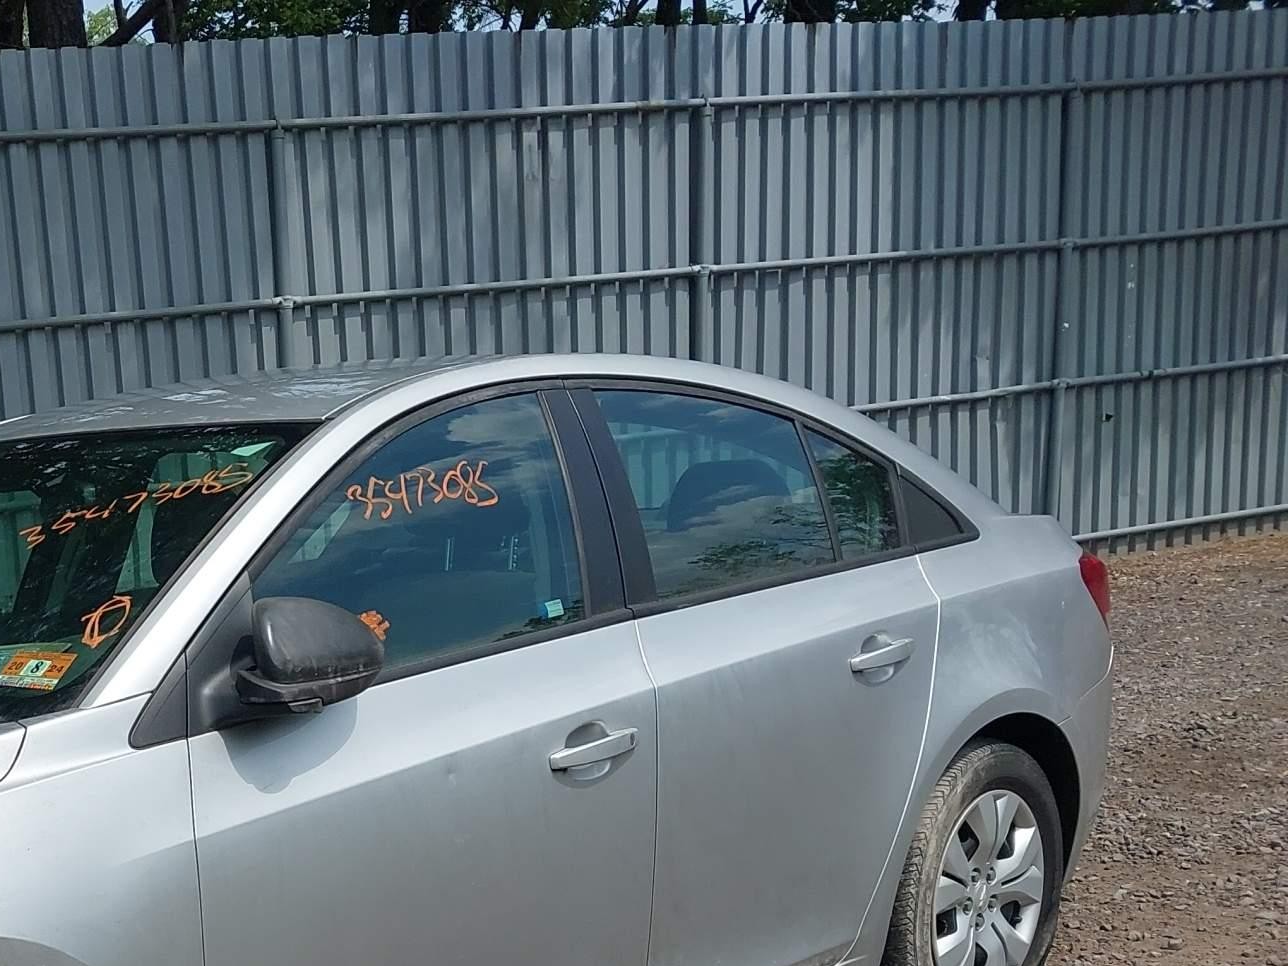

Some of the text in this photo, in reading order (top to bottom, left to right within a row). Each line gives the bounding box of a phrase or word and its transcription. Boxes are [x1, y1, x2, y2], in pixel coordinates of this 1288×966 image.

[19, 462, 253, 549] 35473085
[346, 459, 499, 520] 35473085
[7, 660, 64, 674] 20 8 24
